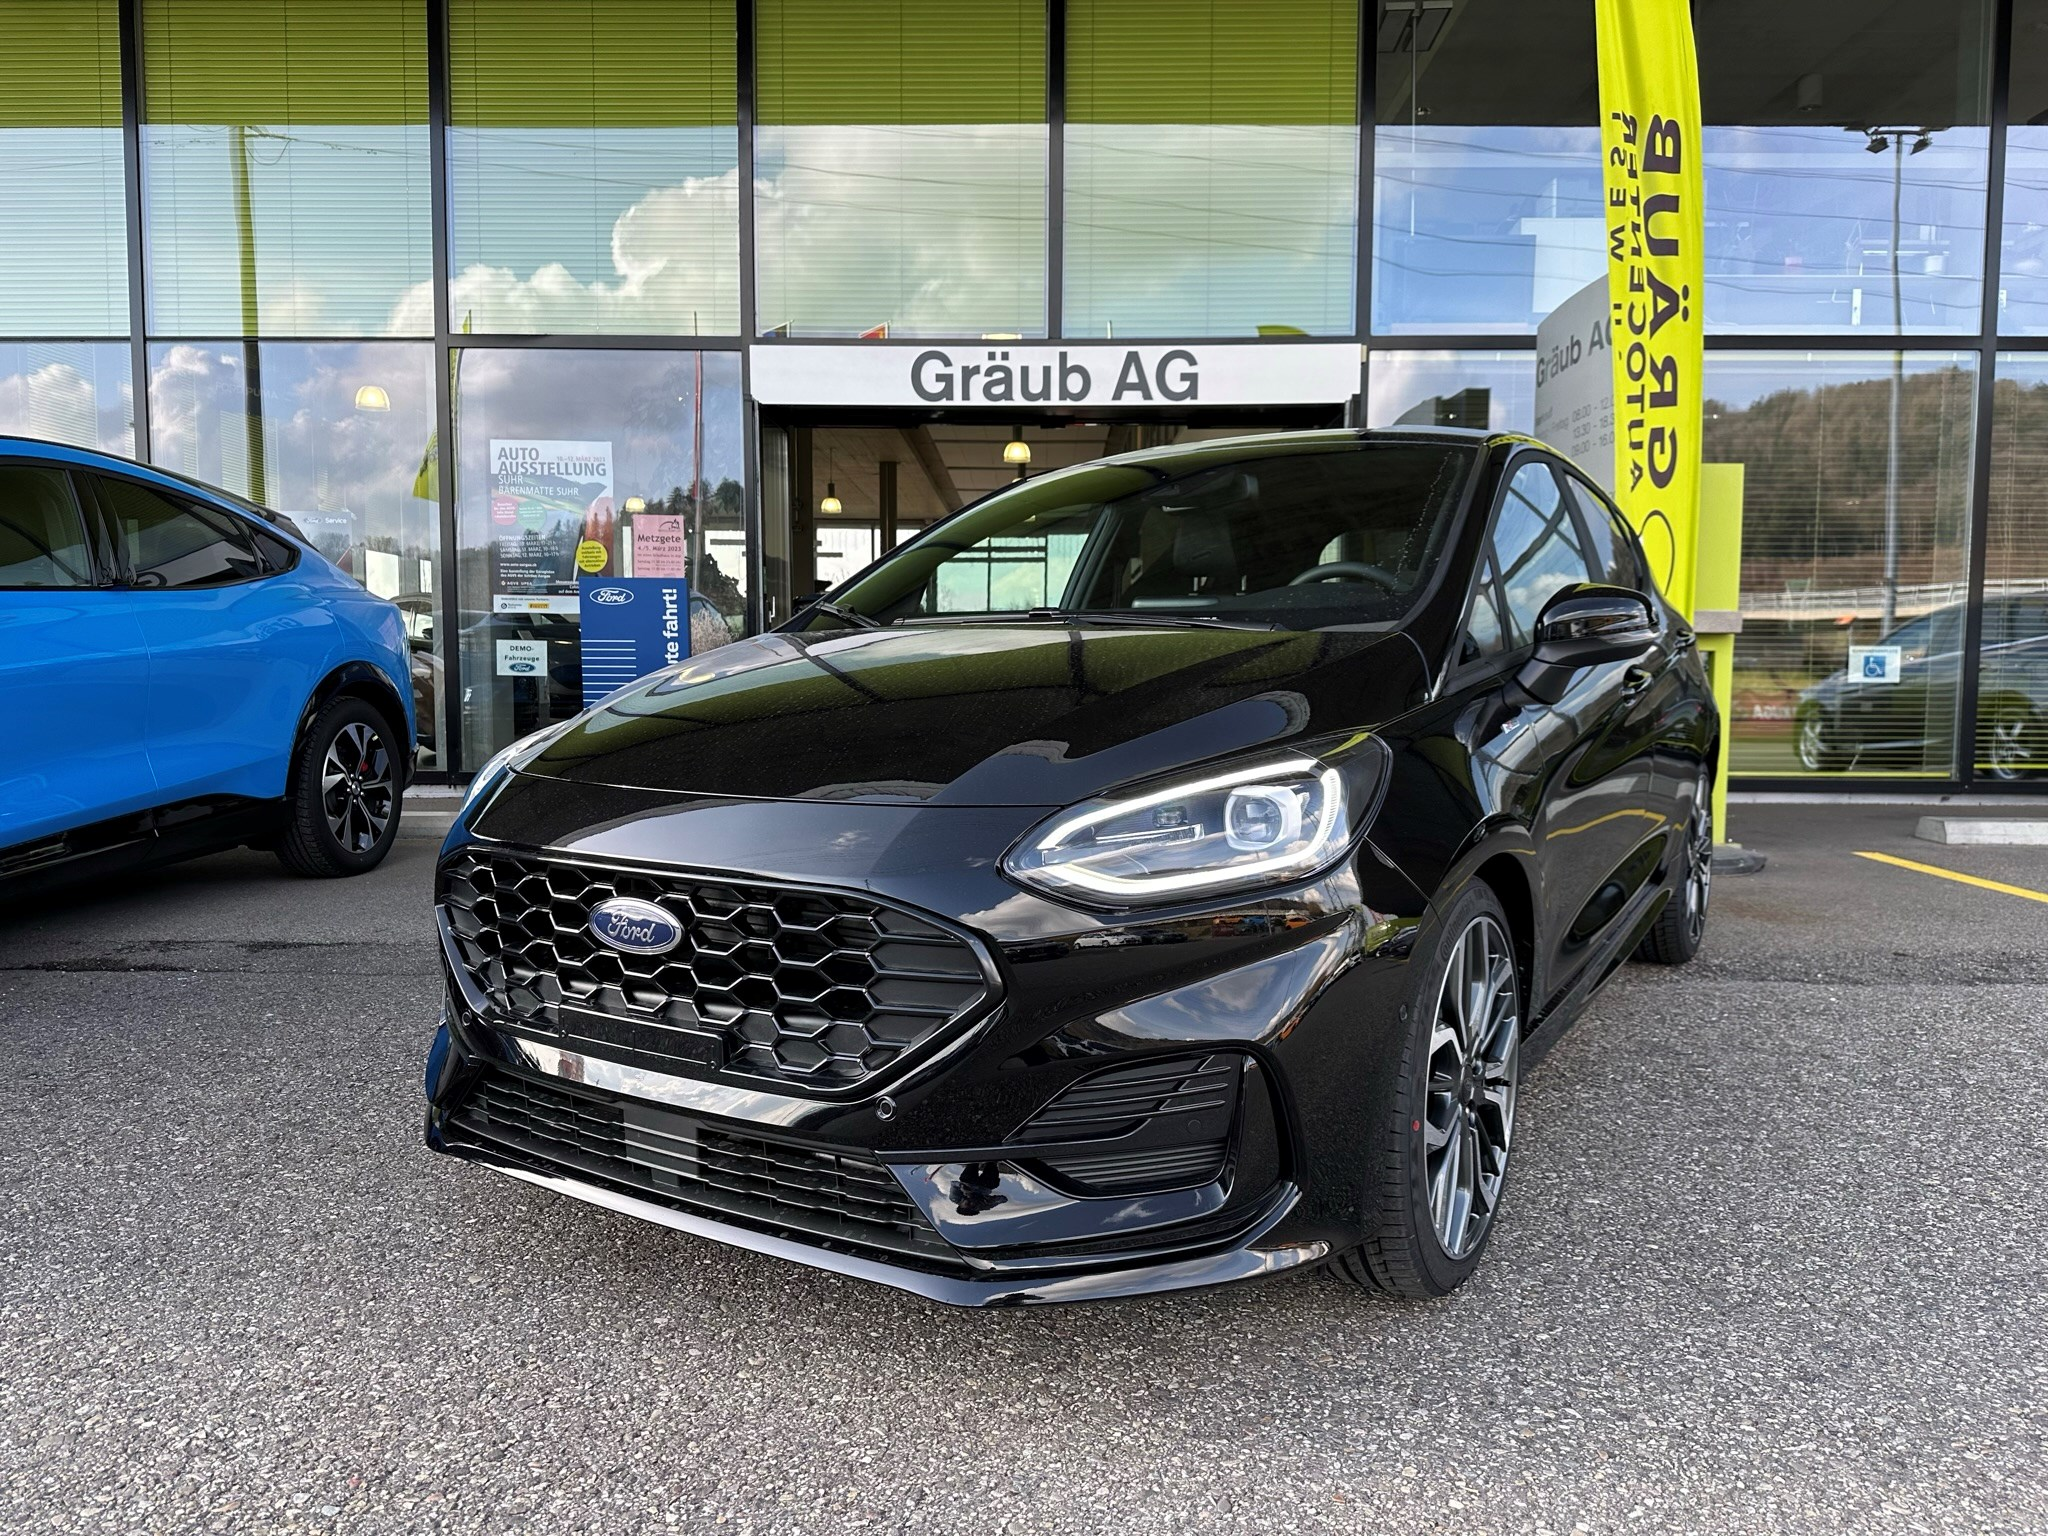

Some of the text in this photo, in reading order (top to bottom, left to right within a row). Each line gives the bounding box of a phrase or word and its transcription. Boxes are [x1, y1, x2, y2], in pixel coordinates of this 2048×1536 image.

[1537, 334, 1582, 388] Gräub
[911, 350, 1199, 402] Gräub AG
[498, 447, 539, 461] AUTO
[498, 462, 607, 476] AUSSTELLUNG
[498, 475, 523, 485] SUHR
[557, 486, 579, 496] SUHR
[638, 534, 681, 544] Metzgete
[597, 590, 626, 603] Ford
[662, 589, 678, 639] fahrt!
[607, 911, 656, 943] Ford
